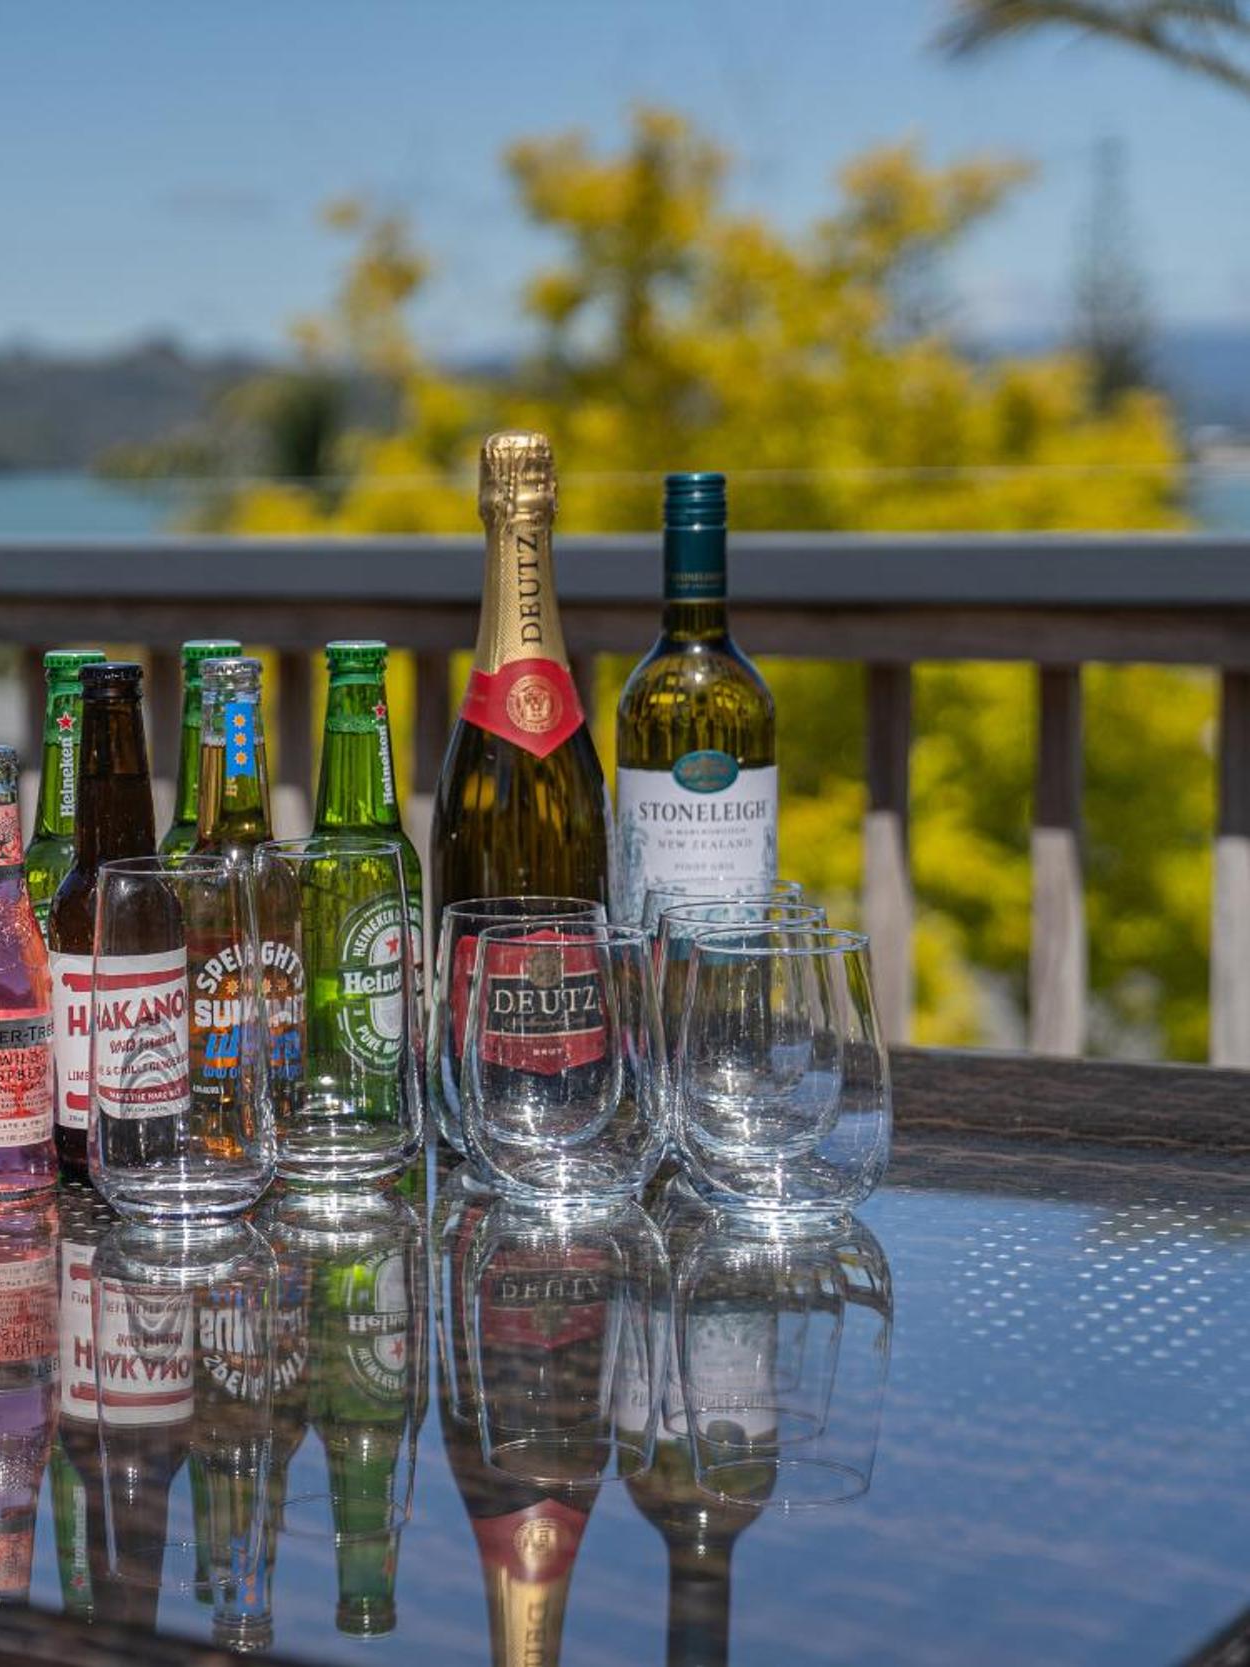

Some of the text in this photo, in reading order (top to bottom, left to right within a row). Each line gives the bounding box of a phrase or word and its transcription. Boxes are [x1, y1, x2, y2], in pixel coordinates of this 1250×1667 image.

[516, 531, 543, 647] DEUTZ
[60, 737, 75, 817] Heineken
[379, 725, 394, 805] Heineken
[638, 800, 767, 822] STONELEIGH
[67, 988, 190, 1036] HAKANO
[493, 985, 597, 1014] DEUTZ
[357, 1024, 383, 1051] PURE
[532, 1048, 562, 1056] BRUT
